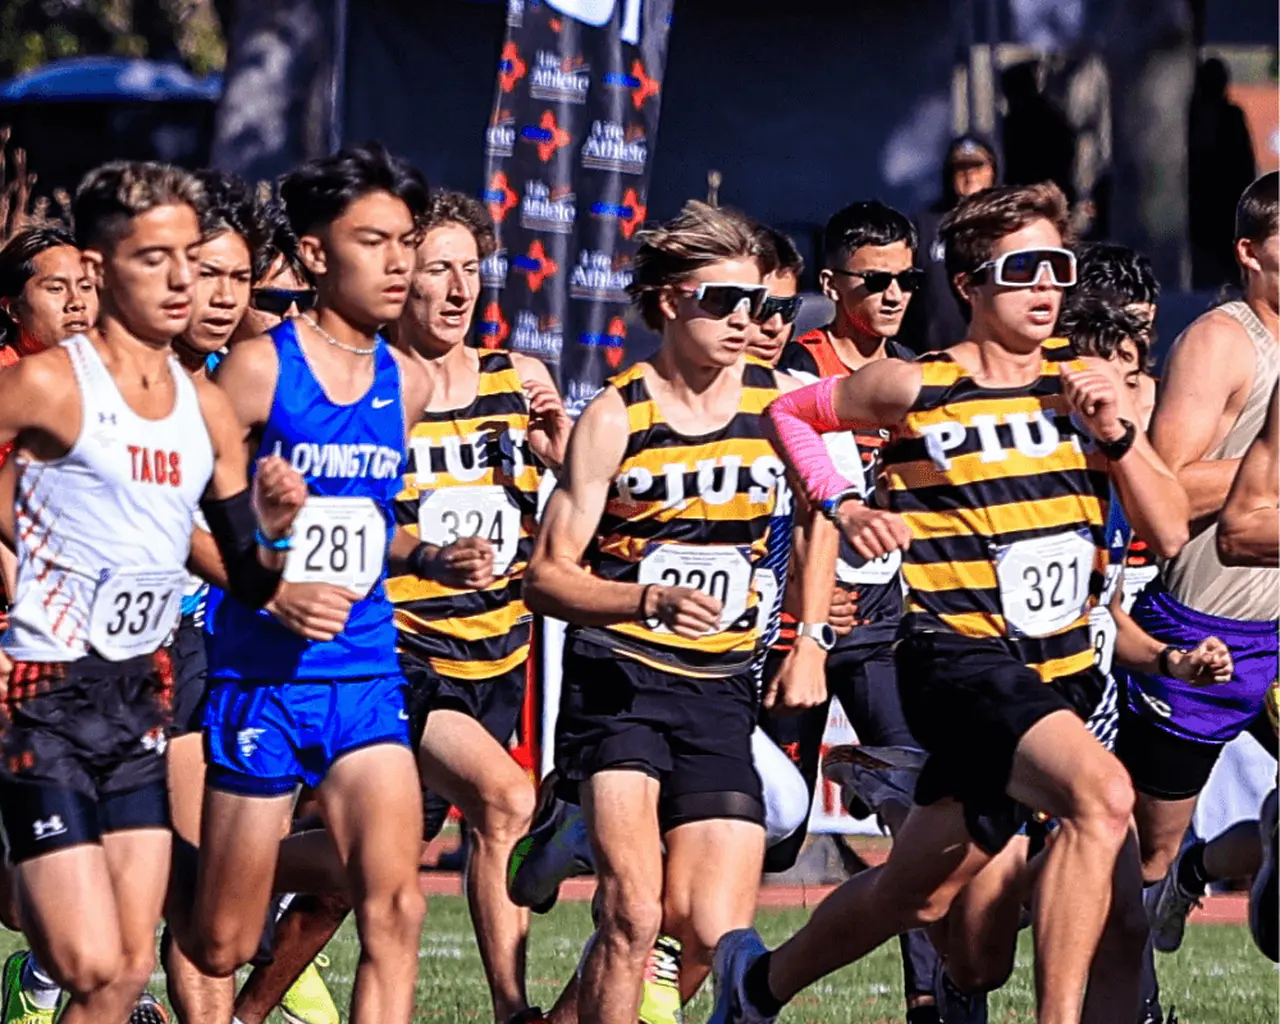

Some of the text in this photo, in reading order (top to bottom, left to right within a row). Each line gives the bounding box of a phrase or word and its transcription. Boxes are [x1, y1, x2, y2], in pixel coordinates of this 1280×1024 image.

[127, 445, 182, 487] TAOS
[616, 455, 786, 510] PIUS
[305, 524, 368, 573] 281
[1023, 556, 1079, 612] 321
[106, 589, 174, 636] 331
